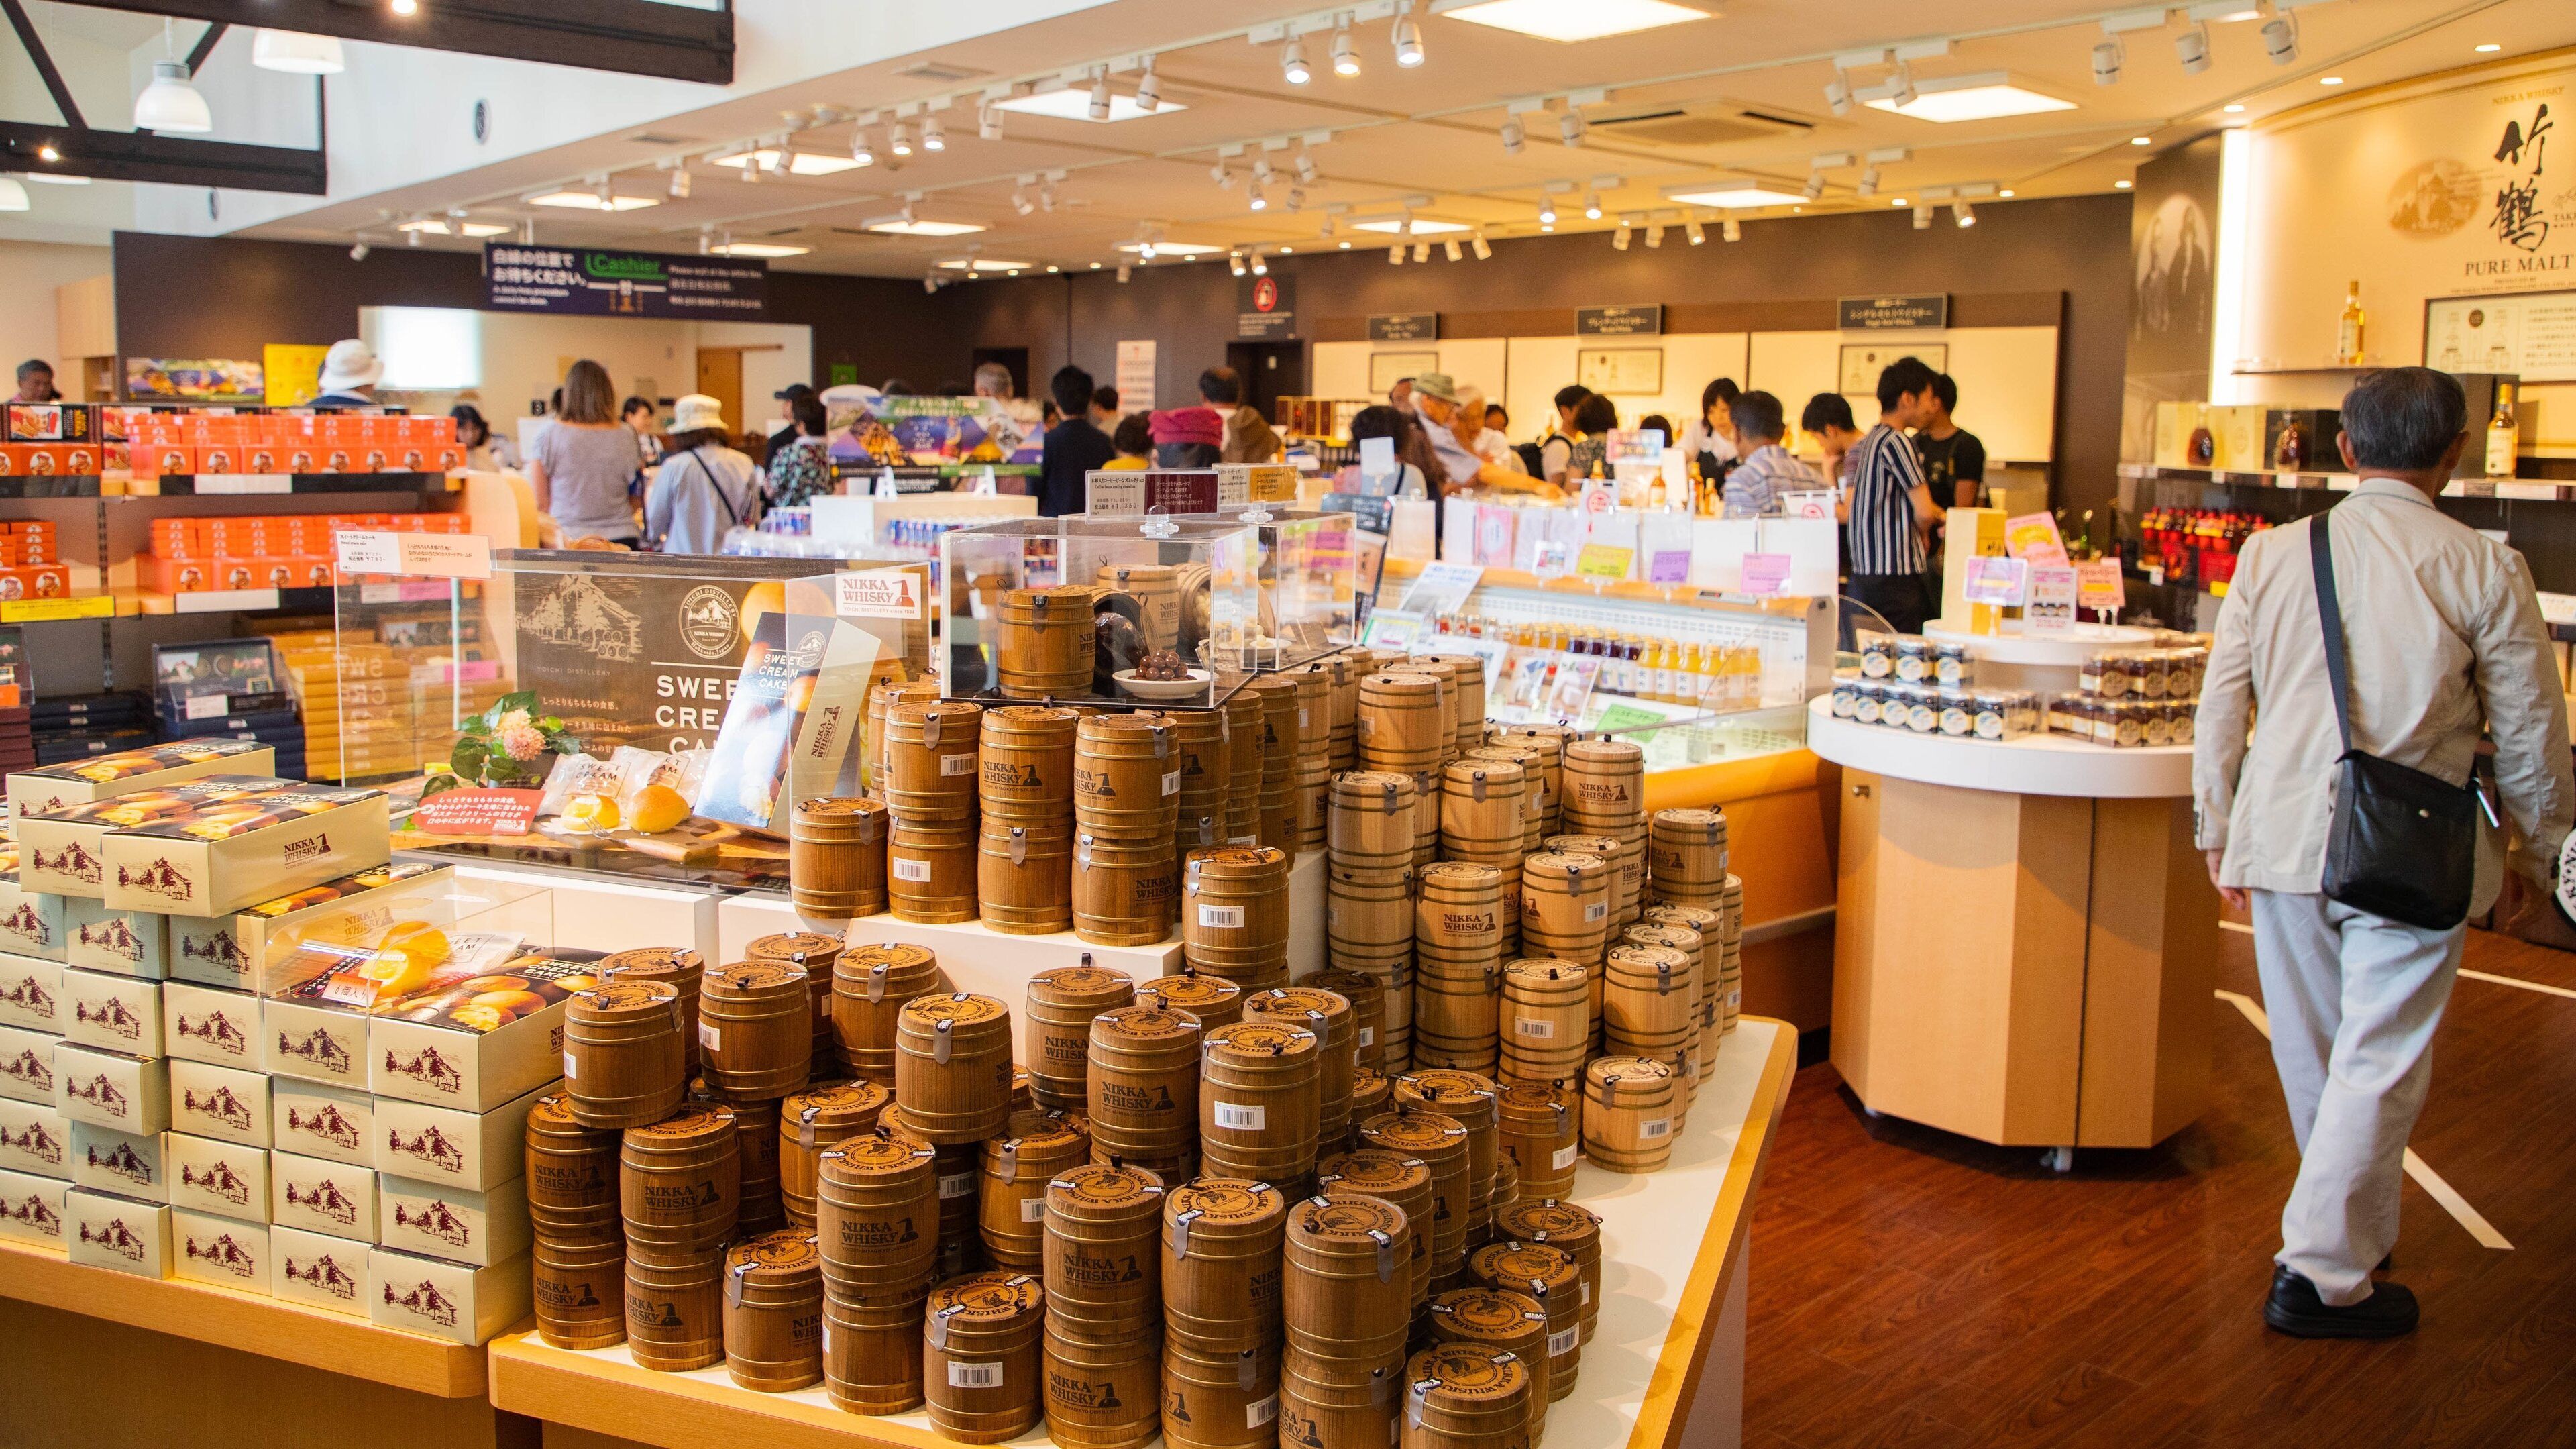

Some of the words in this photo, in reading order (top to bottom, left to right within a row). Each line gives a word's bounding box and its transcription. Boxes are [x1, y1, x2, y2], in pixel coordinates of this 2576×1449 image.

[2465, 258, 2512, 276] PURE
[2518, 253, 2575, 272] MALT
[843, 578, 890, 590] NIKKA
[684, 588, 703, 610] YOICHI
[704, 588, 737, 618] DISTILLERY
[843, 591, 894, 603] WHISKY
[1079, 632, 1095, 643] NIK
[1079, 641, 1095, 652] WHIS
[763, 653, 802, 666] SWEET
[759, 666, 799, 678] CREAM
[657, 675, 737, 700] SWEE
[759, 678, 788, 690] CAKE
[542, 697, 619, 710] しっとりもちもちの食感。
[655, 706, 720, 731] CRE
[669, 737, 716, 755] CA
[811, 722, 828, 758] NIKKA
[816, 720, 834, 760] WHISKY
[983, 761, 1018, 773] NIKKA
[1075, 768, 1093, 781] KKA
[983, 771, 1022, 785] WHISKY
[1075, 780, 1097, 792] HISKY
[1578, 782, 1611, 792] NIKKA
[439, 796, 517, 804] しっとりもちもちの食感。
[1578, 790, 1615, 801] WHISKY
[435, 803, 531, 812] やわらかケーキ生地に包まれた
[427, 816, 492, 825] 口の中に広がります。
[284, 837, 315, 854] NIKKA
[284, 845, 319, 863] WHISKY
[1136, 876, 1171, 889] NIKKA
[345, 910, 377, 926] NIKKA
[1444, 913, 1481, 923] NIKKA
[345, 918, 381, 938] WHISKY
[1444, 921, 1485, 931] WHISKY
[523, 969, 569, 979] CAKE
[527, 965, 584, 976] CREAM
[1044, 1035, 1089, 1049] NIKKA
[1045, 1046, 1089, 1059] WHISK
[1102, 1081, 1148, 1099] NIKKA
[1102, 1093, 1152, 1108] WHISKY
[535, 1163, 578, 1179] NIKKA
[535, 1174, 583, 1189] WHISKY
[645, 1185, 694, 1198] NIKKA
[645, 1193, 699, 1208] WHISKY
[841, 1218, 894, 1233] NIKKA
[841, 1230, 898, 1244] WHISKY
[1064, 1253, 1115, 1269] NIKKA
[1064, 1264, 1121, 1282] WHISKY
[1251, 1268, 1281, 1287] NIK
[536, 1278, 572, 1295] NIKKA
[536, 1288, 577, 1305] WHISKY
[625, 1291, 655, 1312] NIKKA
[625, 1303, 661, 1324] WHISKY
[793, 1314, 823, 1329] NIK
[793, 1324, 823, 1340] WHI
[1049, 1370, 1092, 1393] NIKKA
[1049, 1382, 1098, 1405] WHISKY
[1280, 1405, 1299, 1426] KKA
[1280, 1414, 1302, 1438] ISKY
